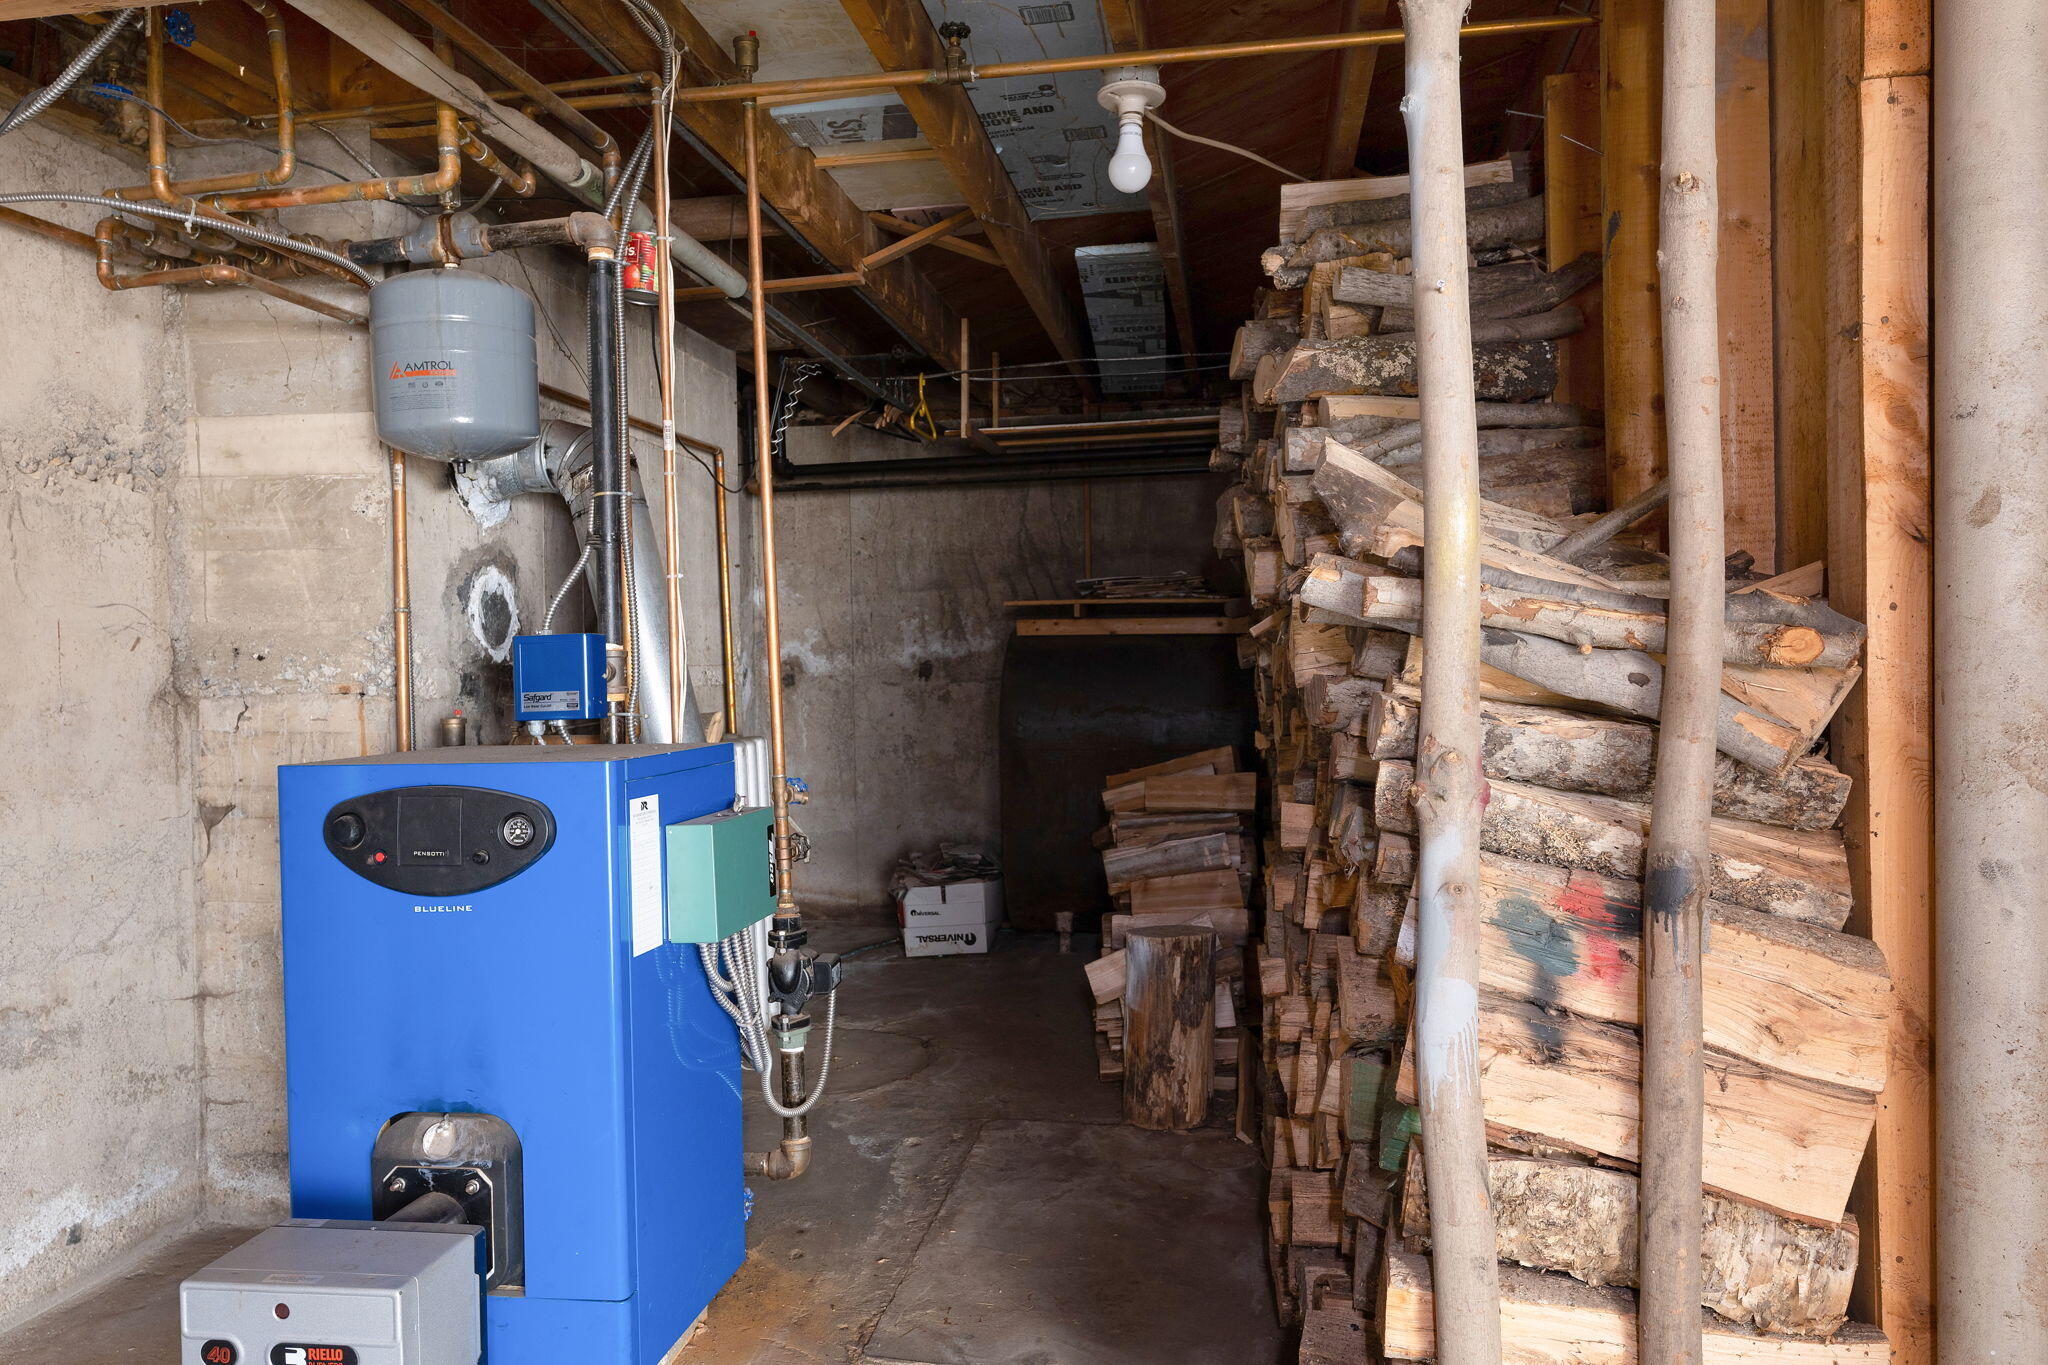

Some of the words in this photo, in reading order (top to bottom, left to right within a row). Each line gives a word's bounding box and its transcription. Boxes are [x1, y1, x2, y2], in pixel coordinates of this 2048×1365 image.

[1022, 104, 1055, 116] AND
[404, 360, 454, 372] AMTROL
[523, 694, 552, 703] Safgard
[414, 905, 473, 913] BLUELINE
[206, 1346, 231, 1364] 40
[308, 1347, 343, 1361] RIELLO
